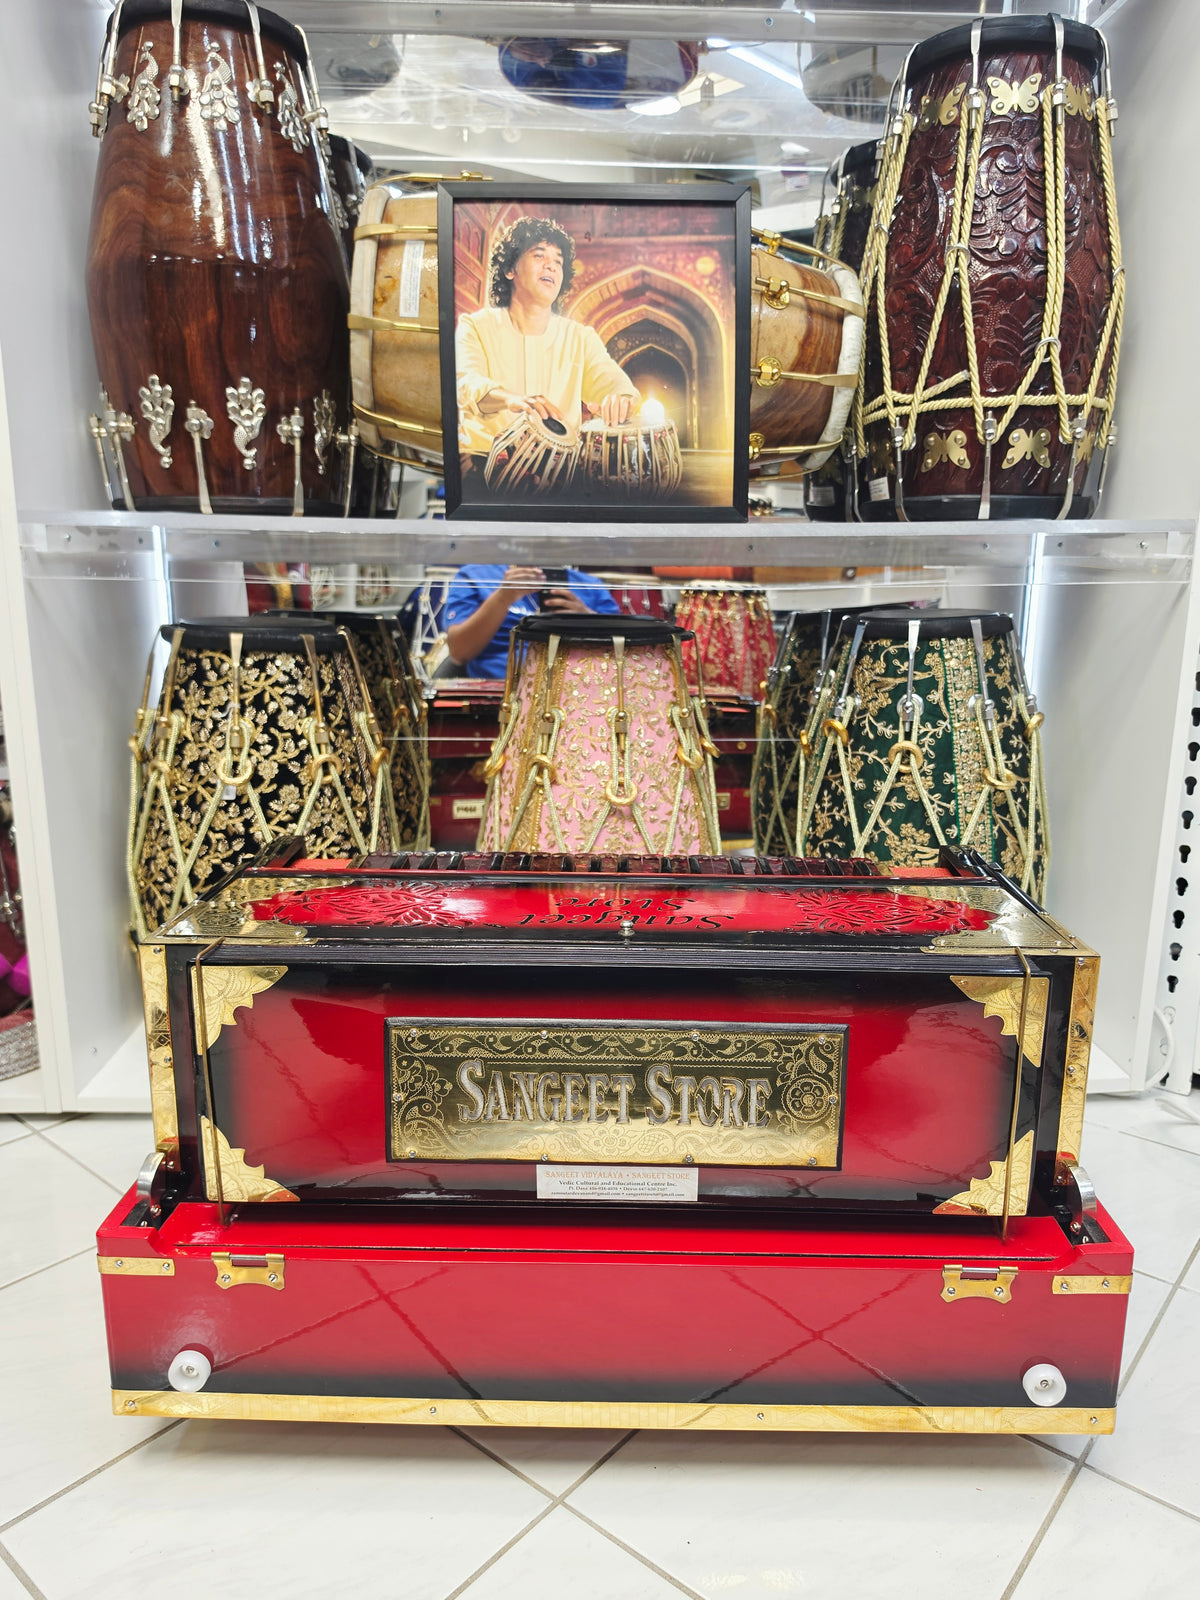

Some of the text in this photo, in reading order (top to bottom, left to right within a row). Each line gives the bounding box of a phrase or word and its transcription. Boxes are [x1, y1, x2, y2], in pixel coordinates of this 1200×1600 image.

[555, 897, 696, 911] Store
[513, 910, 735, 930] Sangeet
[456, 1057, 773, 1128] SANGEET STORE
[580, 1171, 623, 1179] VIDYALAYA
[631, 1172, 666, 1180] SANGEET
